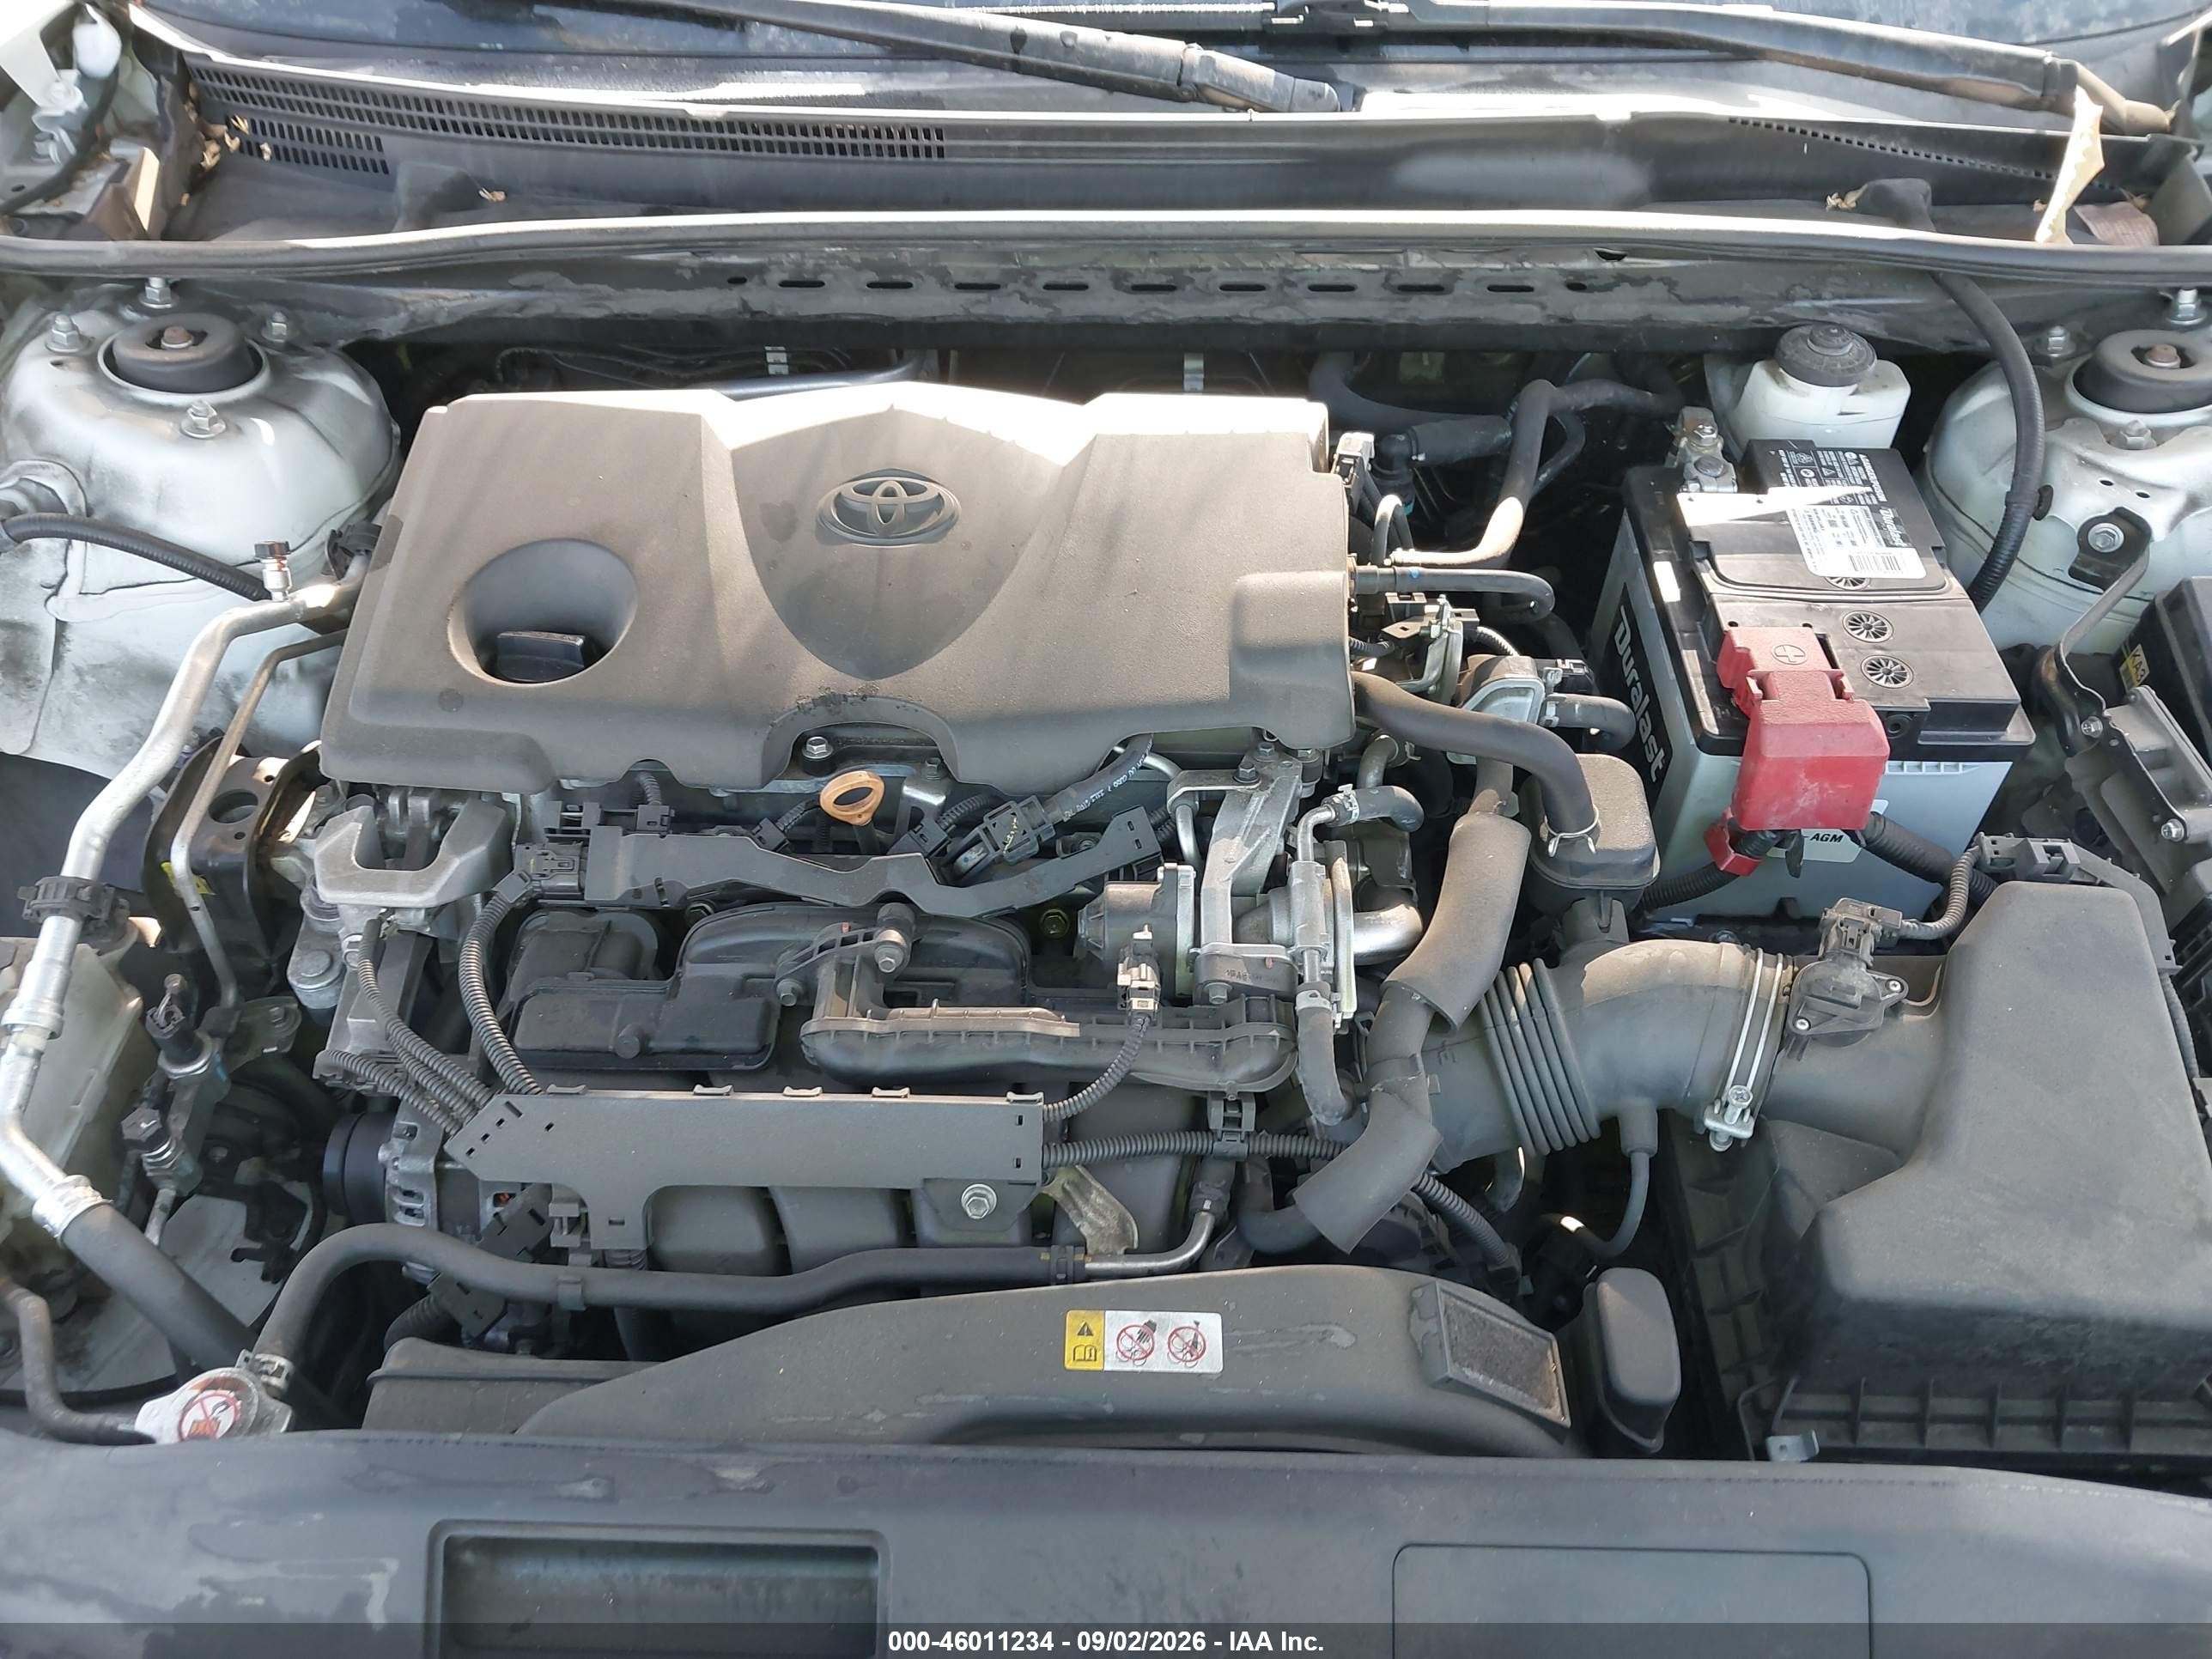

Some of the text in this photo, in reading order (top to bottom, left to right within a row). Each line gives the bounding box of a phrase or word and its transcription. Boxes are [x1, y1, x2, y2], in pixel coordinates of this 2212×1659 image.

[1879, 507, 1908, 548] Duralast
[2131, 648, 2146, 683] KA3
[1613, 605, 1666, 783] Duralast
[1809, 832, 1844, 843] AGM
